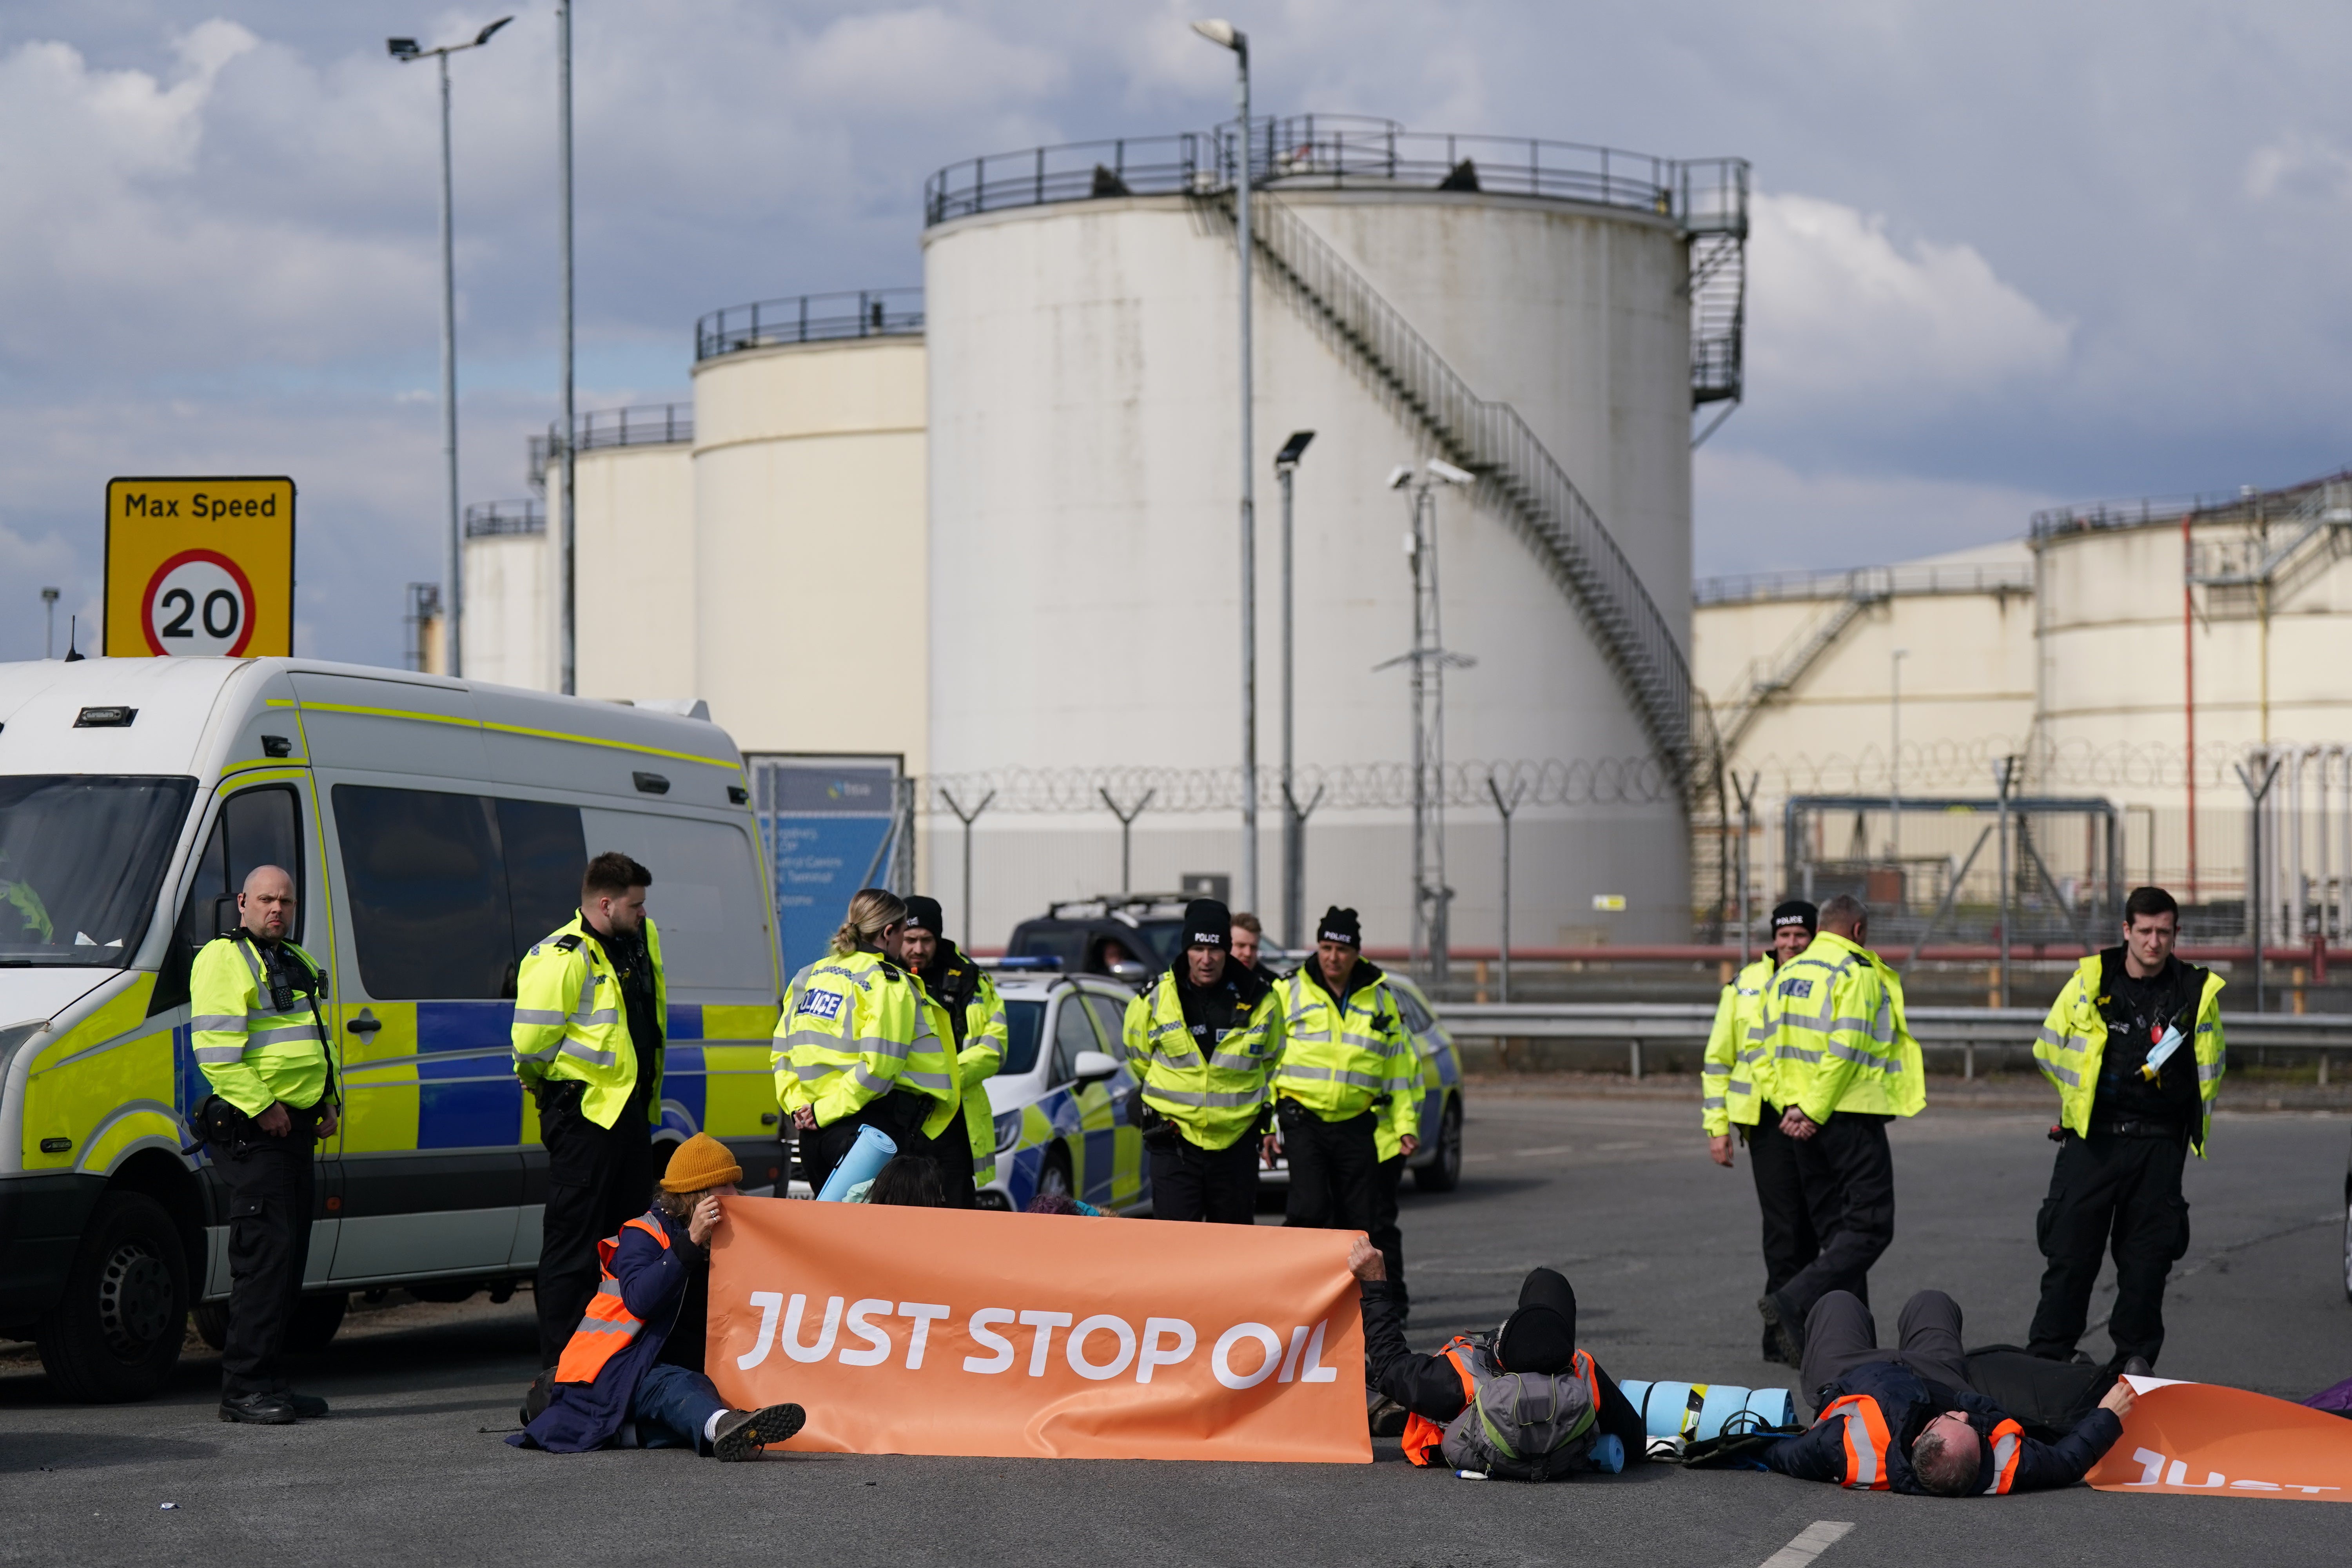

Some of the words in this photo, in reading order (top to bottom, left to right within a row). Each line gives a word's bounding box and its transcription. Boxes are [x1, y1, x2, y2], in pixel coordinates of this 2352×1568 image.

[125, 493, 178, 517] Max
[192, 492, 276, 521] Speed
[162, 588, 238, 638] 20
[1776, 915, 1803, 926] POLICE
[1195, 933, 1220, 944] POLICE
[1324, 931, 1352, 943] POLICE
[799, 992, 840, 1015] OLICE
[737, 1291, 950, 1370] JUST
[963, 1307, 1197, 1383] STOP
[1211, 1318, 1337, 1390] OIL
[2122, 1447, 2341, 1494] JUST
